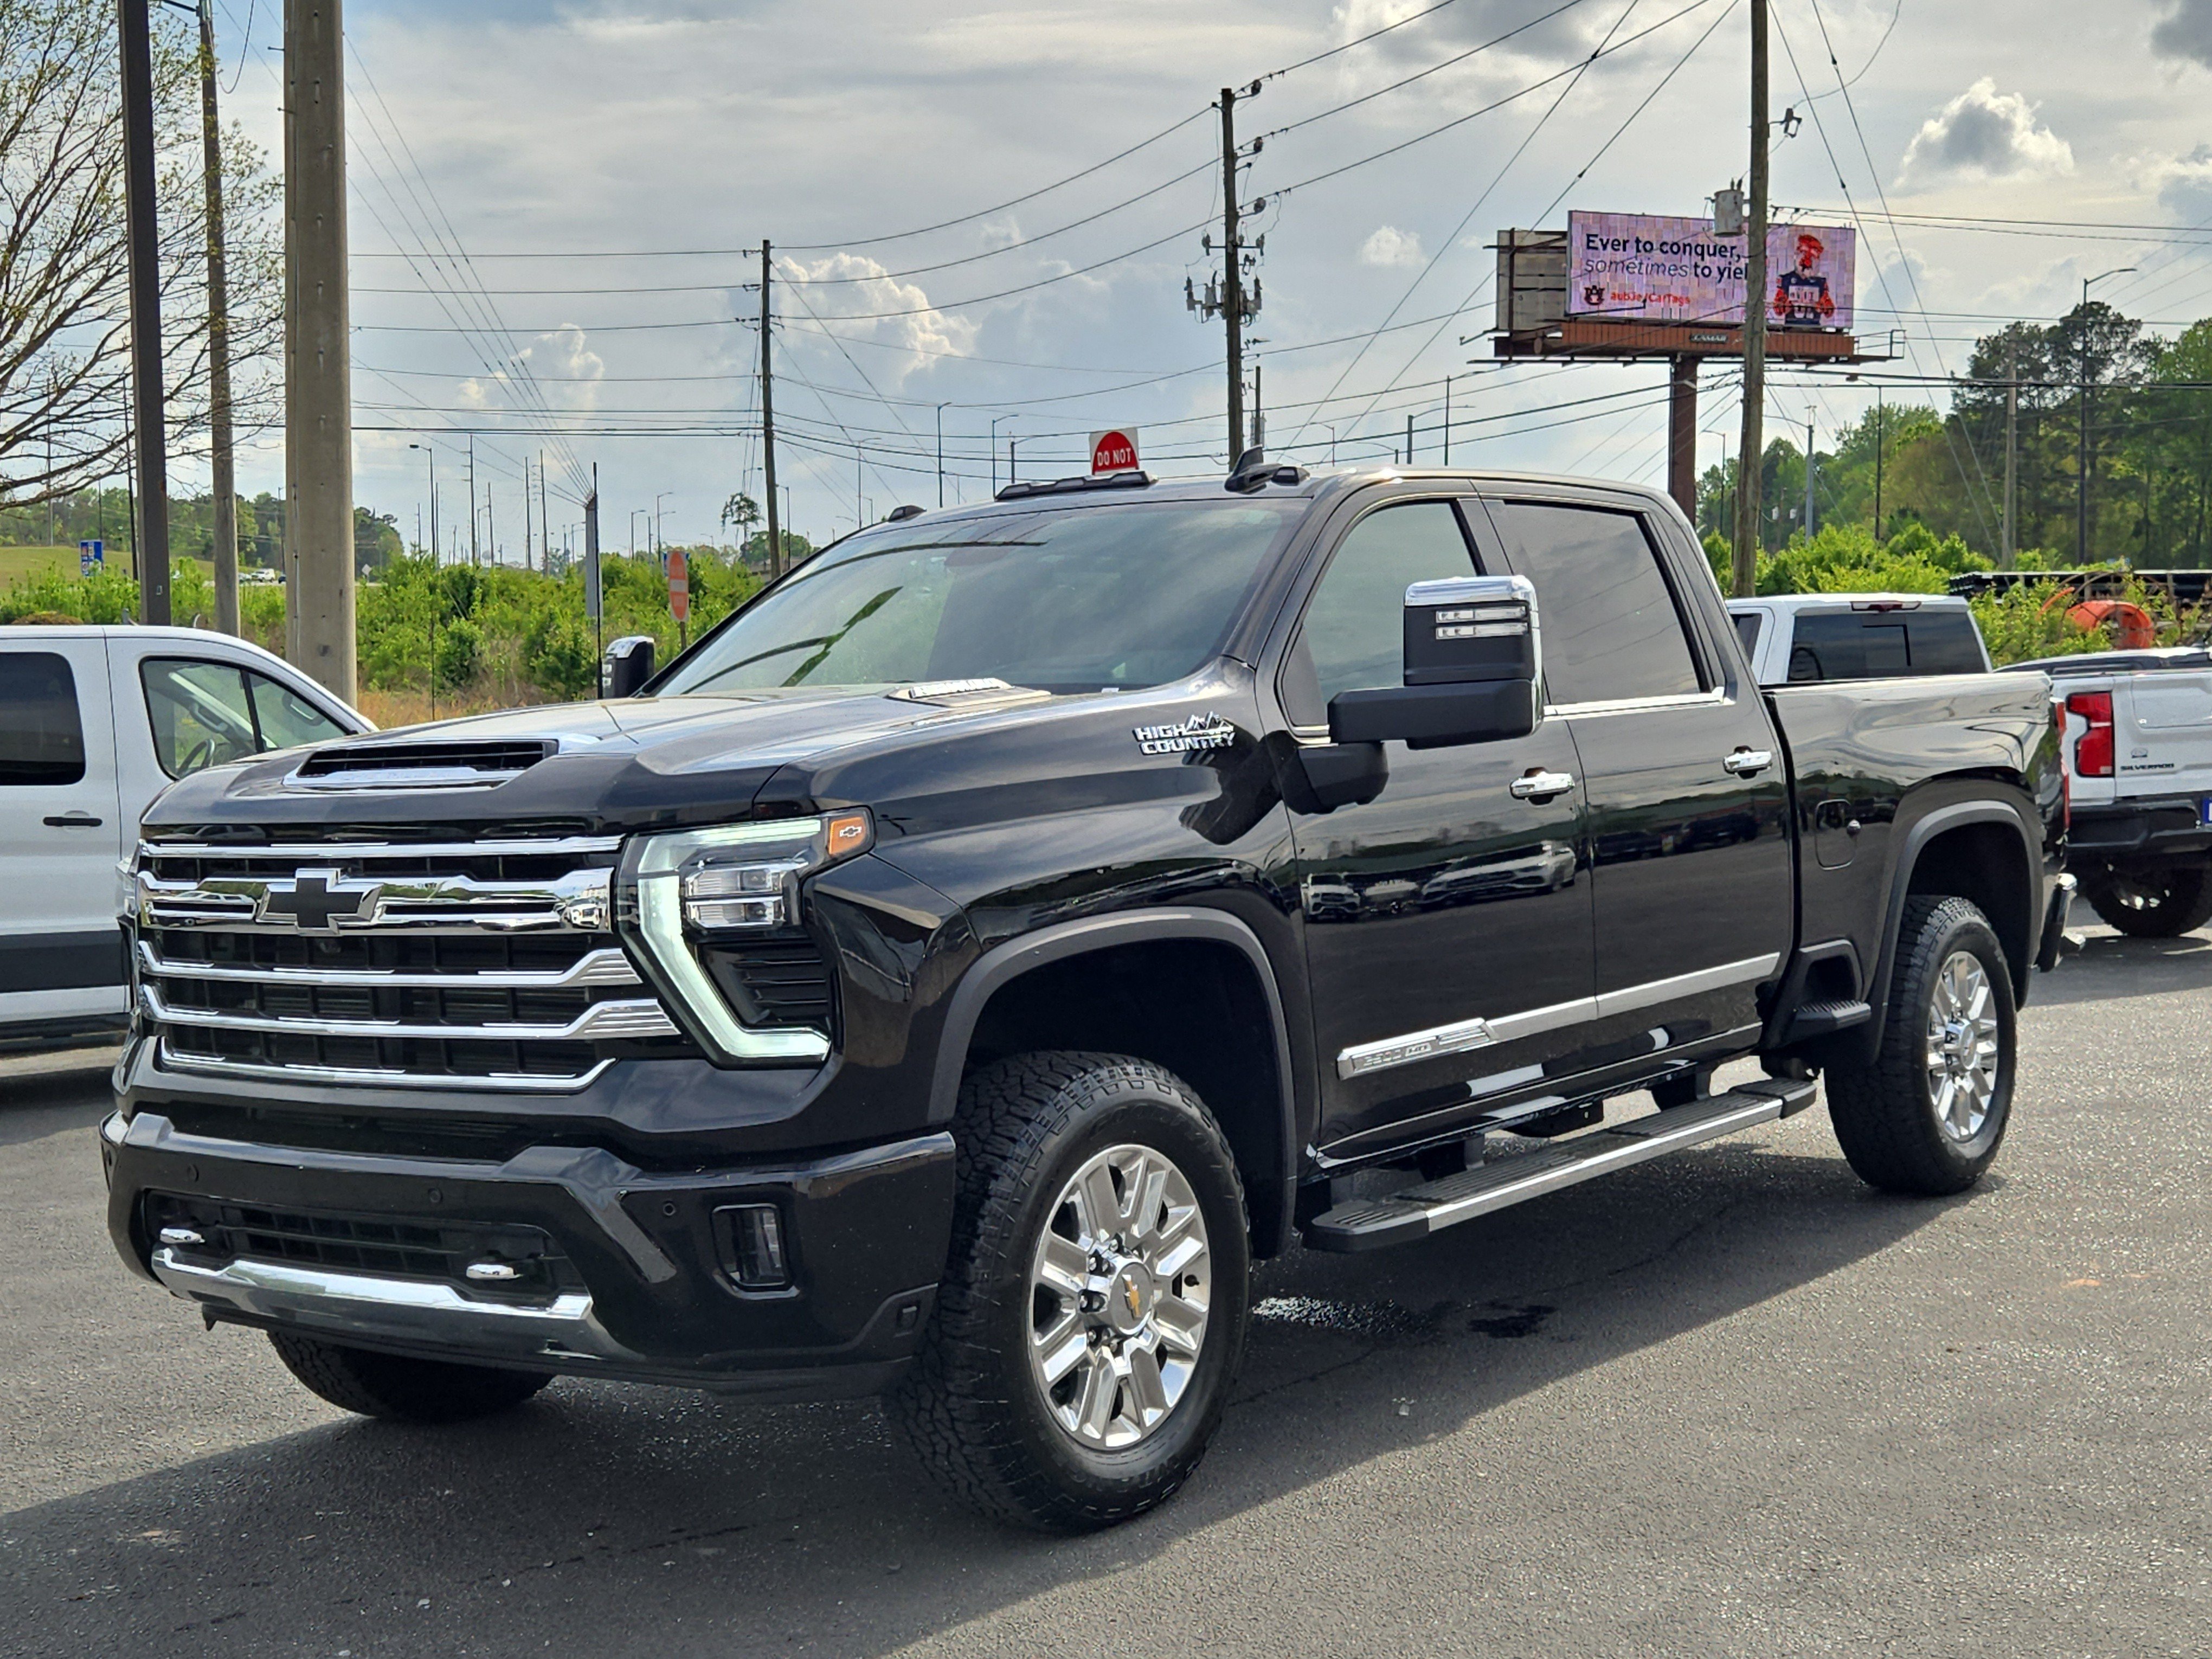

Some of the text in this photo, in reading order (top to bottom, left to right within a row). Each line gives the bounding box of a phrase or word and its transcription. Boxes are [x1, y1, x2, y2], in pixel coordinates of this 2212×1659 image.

[1586, 234, 1741, 262] Ever to conquer,
[1584, 258, 1748, 284] sometimes to yiel
[1097, 448, 1131, 466] DO NOT
[1133, 723, 1187, 741] HIGH
[1140, 732, 1236, 755] COUNTRY
[2120, 763, 2175, 771] SILVERADO
